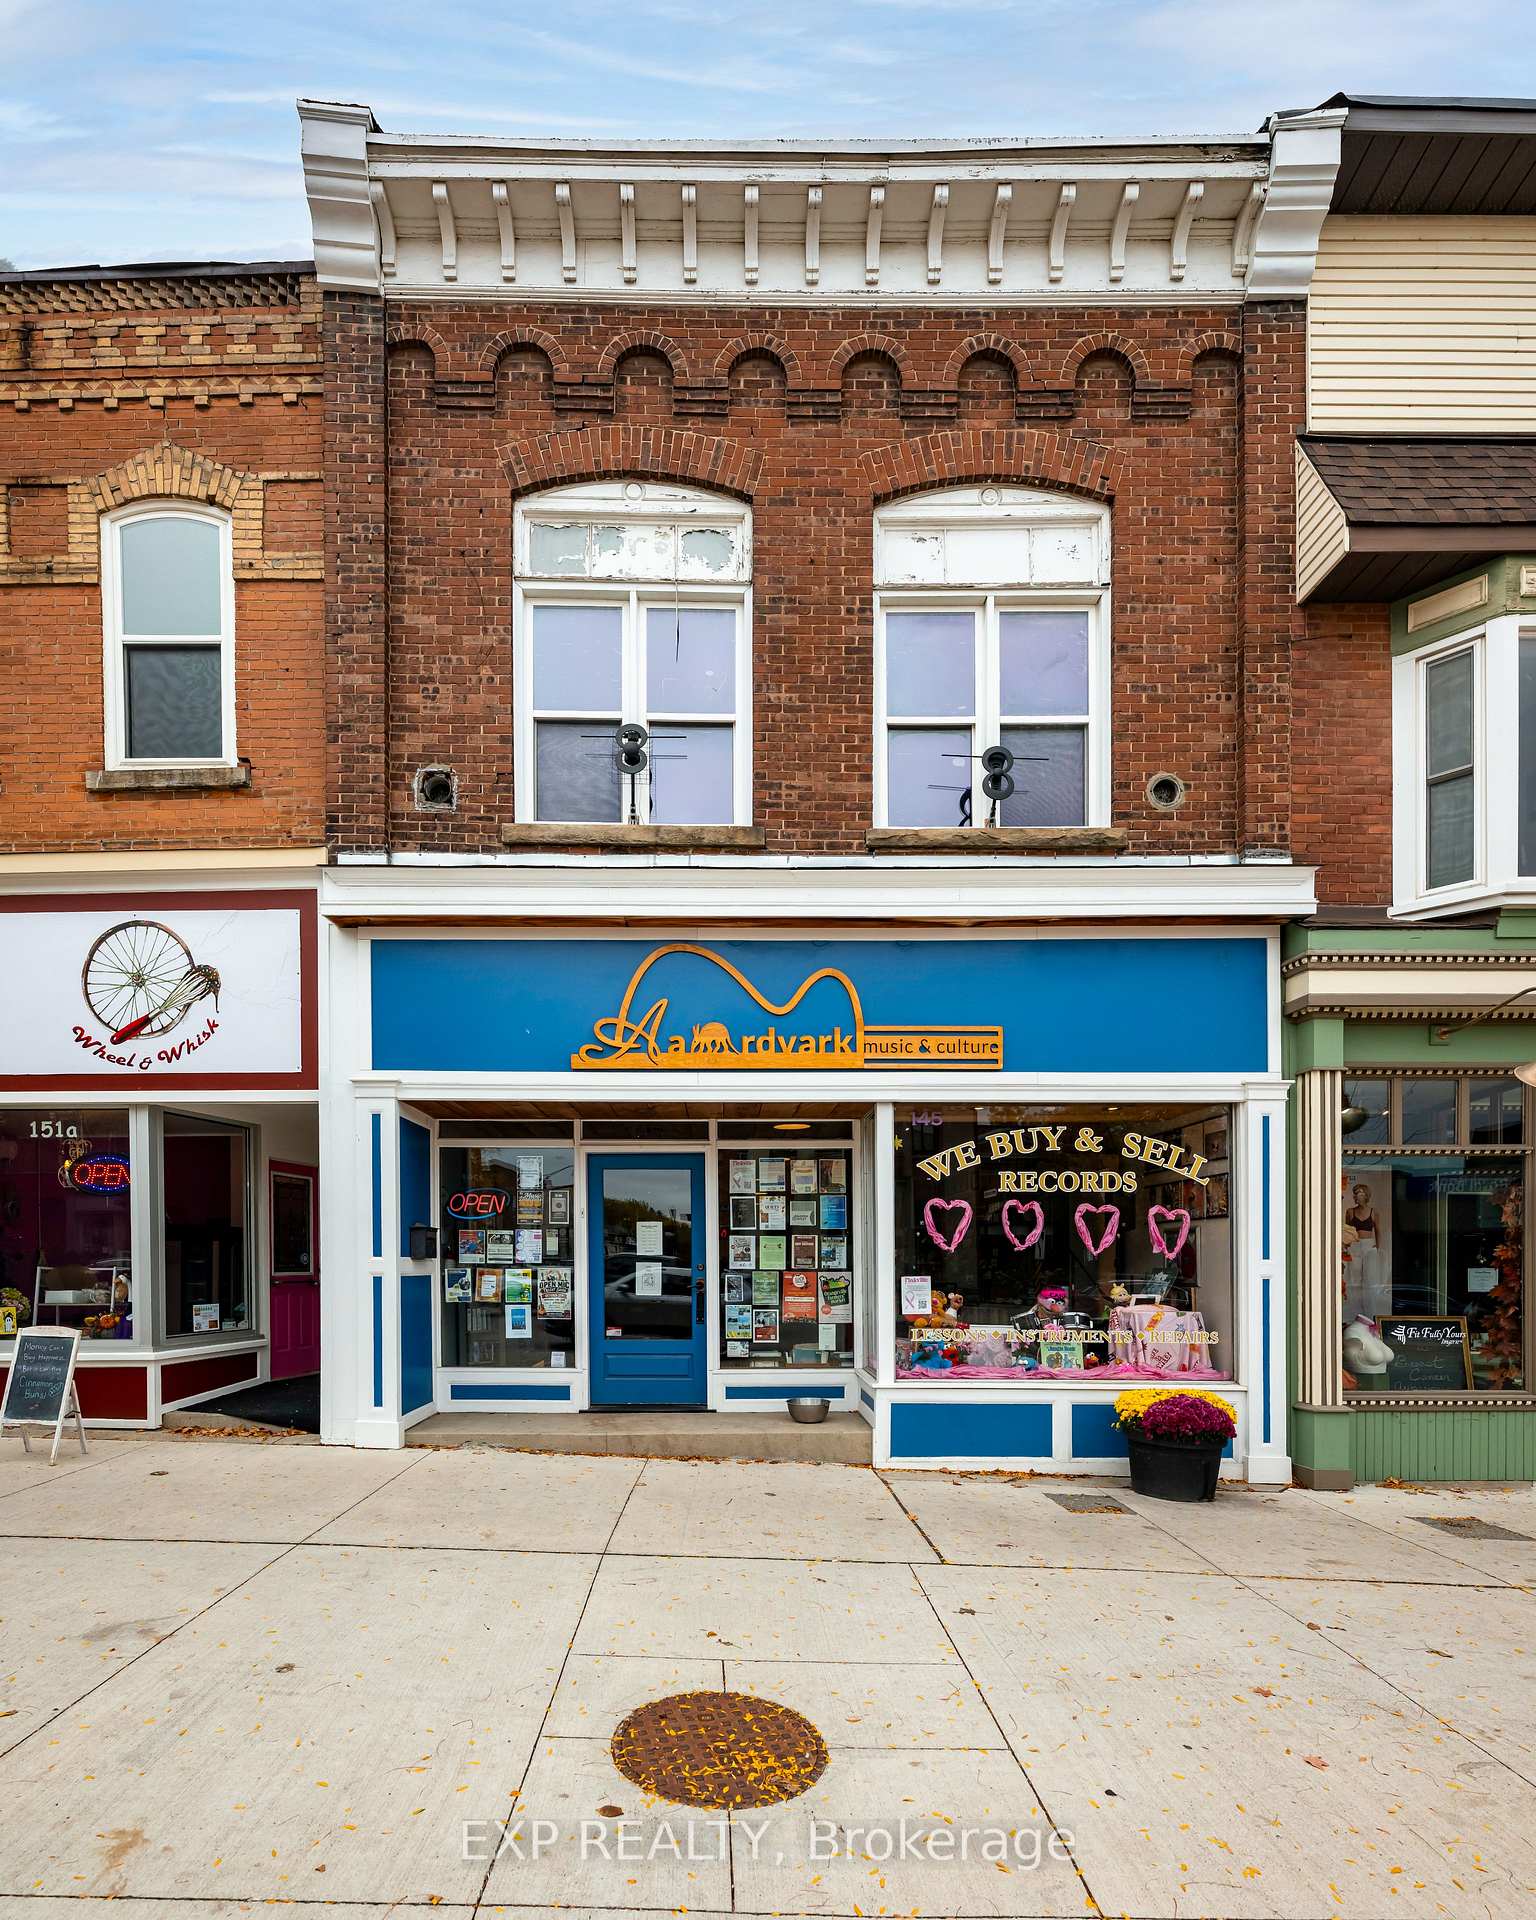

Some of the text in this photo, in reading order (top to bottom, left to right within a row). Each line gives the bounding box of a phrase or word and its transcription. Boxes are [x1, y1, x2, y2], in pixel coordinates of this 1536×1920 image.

[72, 1018, 219, 1070] Wheel & Whisk
[863, 1038, 999, 1054] music & culture
[911, 1111, 944, 1126] 145
[29, 1120, 78, 1138] 151a
[916, 1126, 1210, 1187] WE BUY & SELL
[74, 1163, 132, 1185] OPEN
[997, 1171, 1139, 1193] RECORDS
[449, 1193, 507, 1214] OPEN
[910, 1328, 1220, 1345] LESSONS INSTRUMENTS REPAIRS
[1406, 1325, 1467, 1341] Fit Fully Yours
